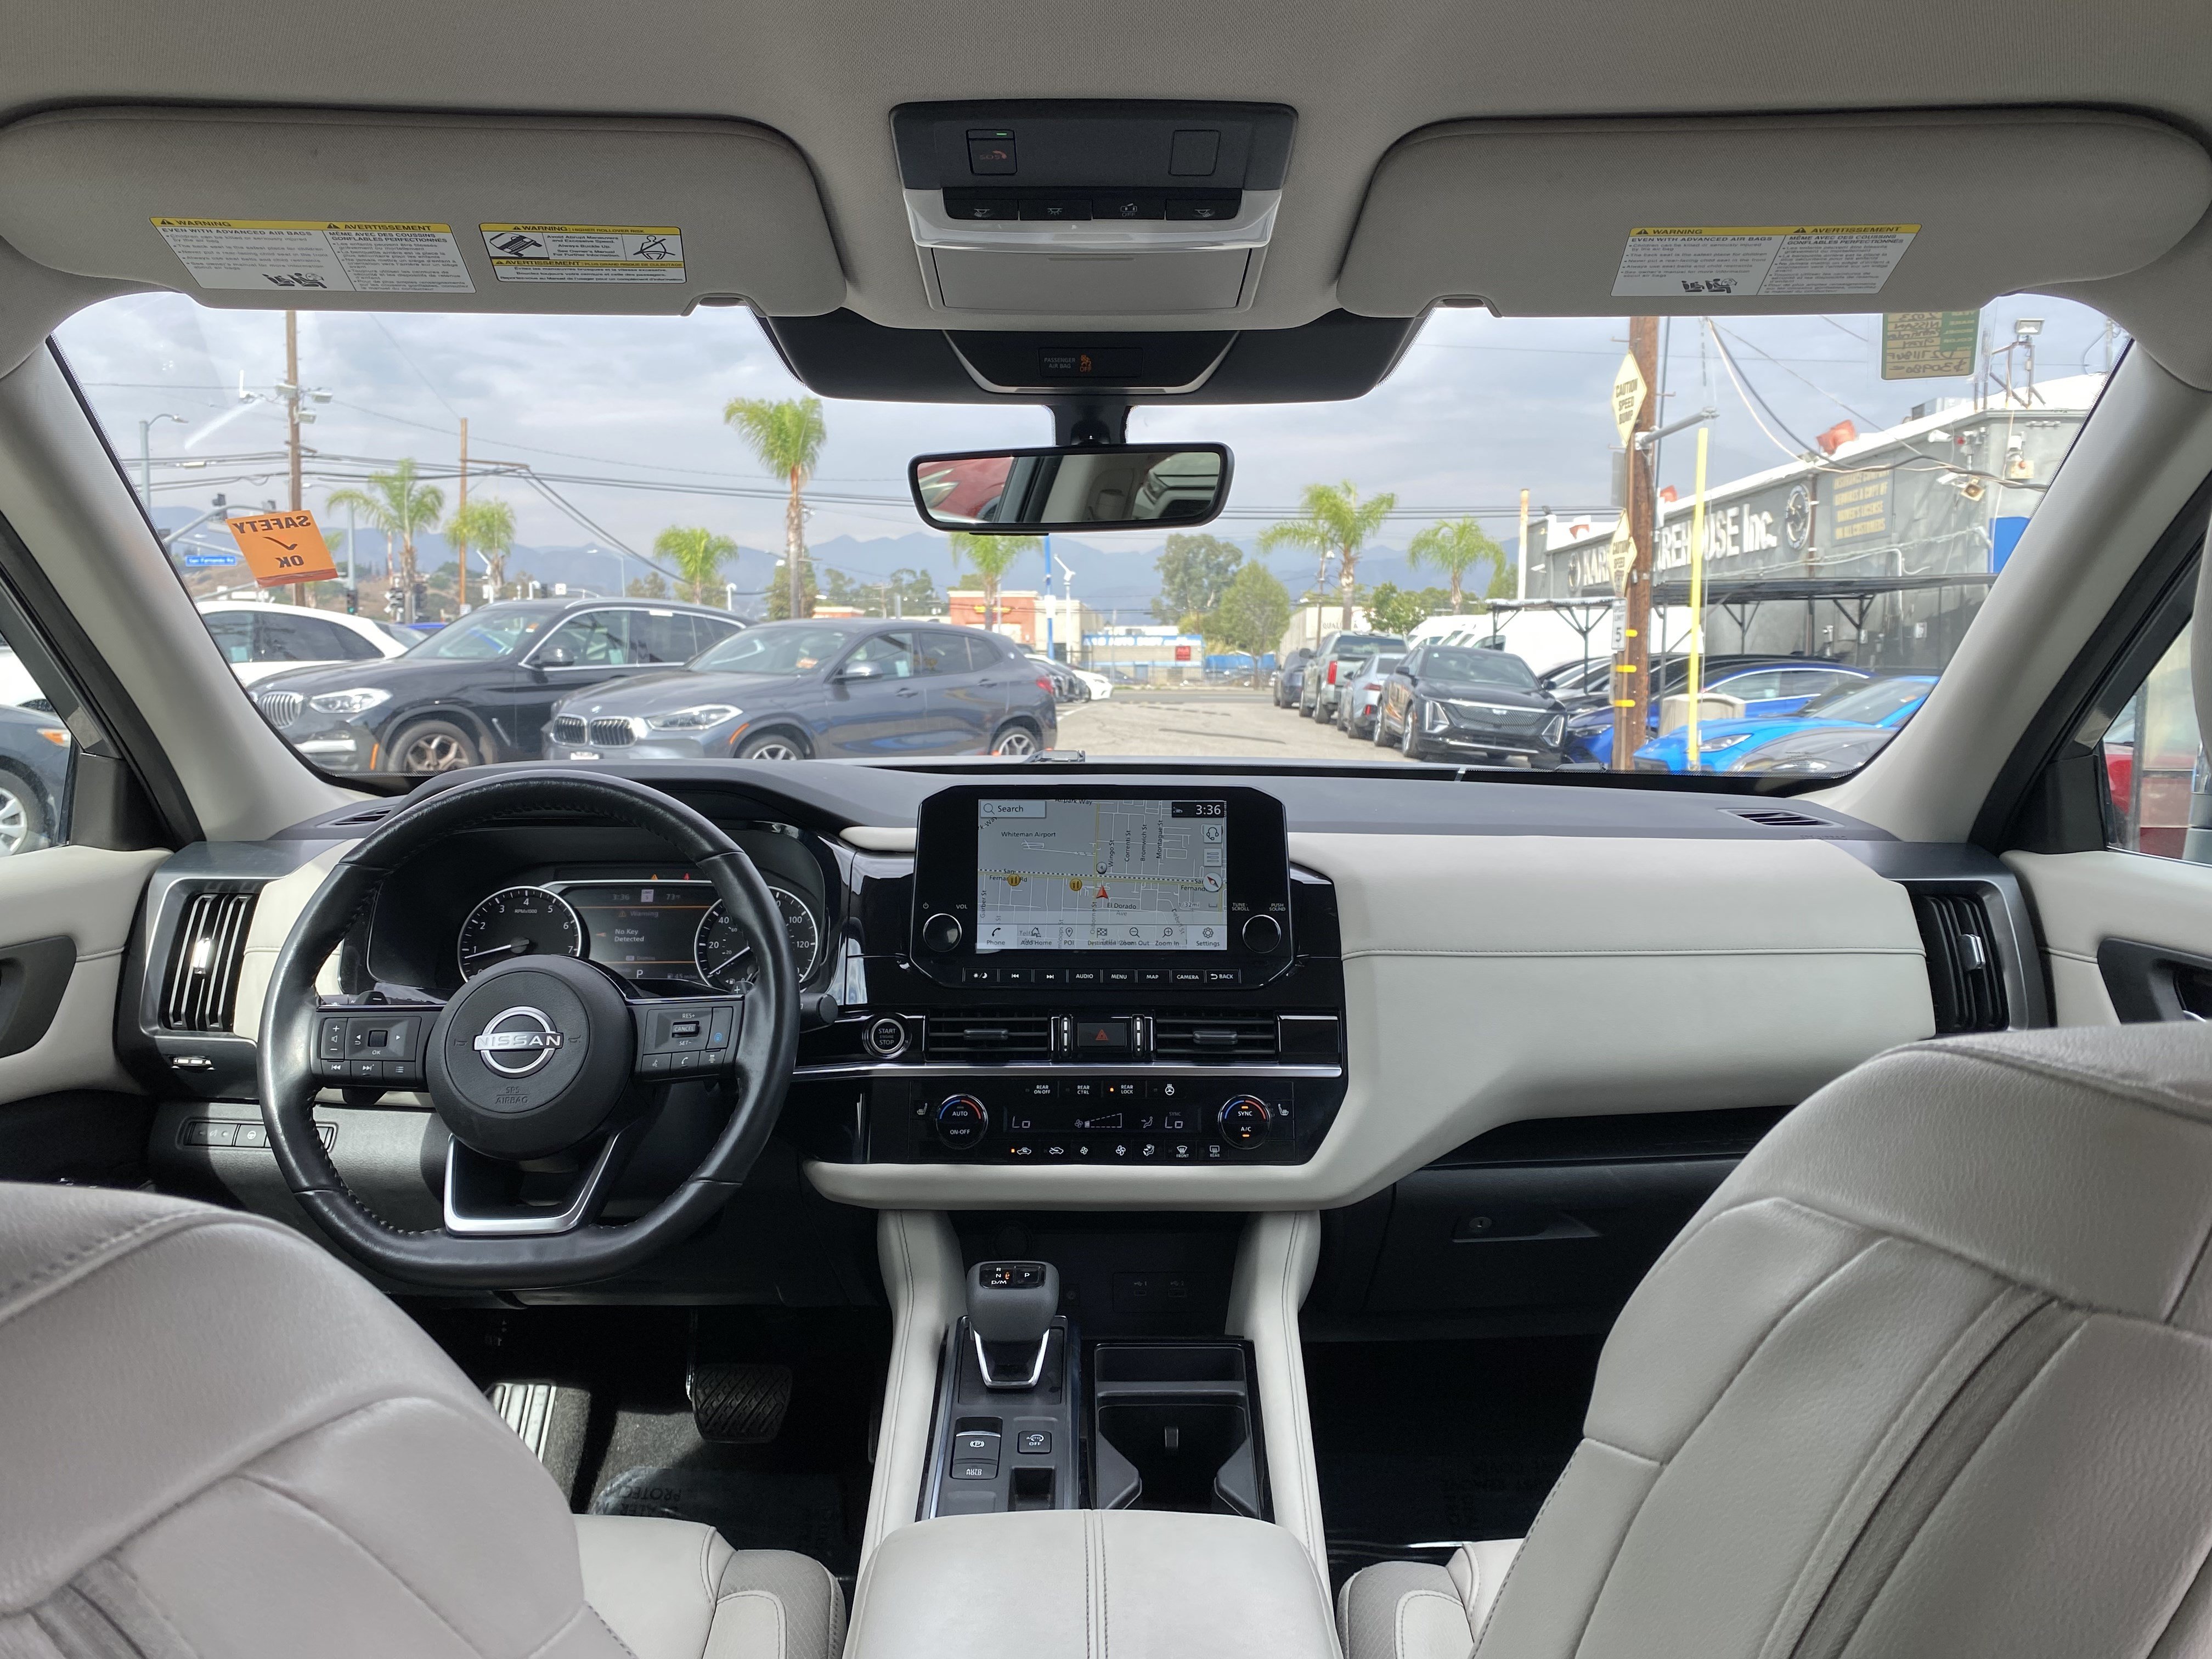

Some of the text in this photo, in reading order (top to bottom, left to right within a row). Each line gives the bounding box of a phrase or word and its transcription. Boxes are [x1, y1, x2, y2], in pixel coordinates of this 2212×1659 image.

[1616, 378, 1638, 398] CAUTION
[1618, 396, 1634, 411] SPEED
[1619, 410, 1633, 425] BUMP
[1743, 503, 1776, 552] Inc.
[1616, 631, 1622, 642] 5
[1195, 805, 1221, 815] 3:36
[636, 969, 643, 979] P
[477, 1036, 561, 1047] NISSAN
[1012, 1116, 1030, 1128] Lo
[1165, 1116, 1183, 1129] Lo
